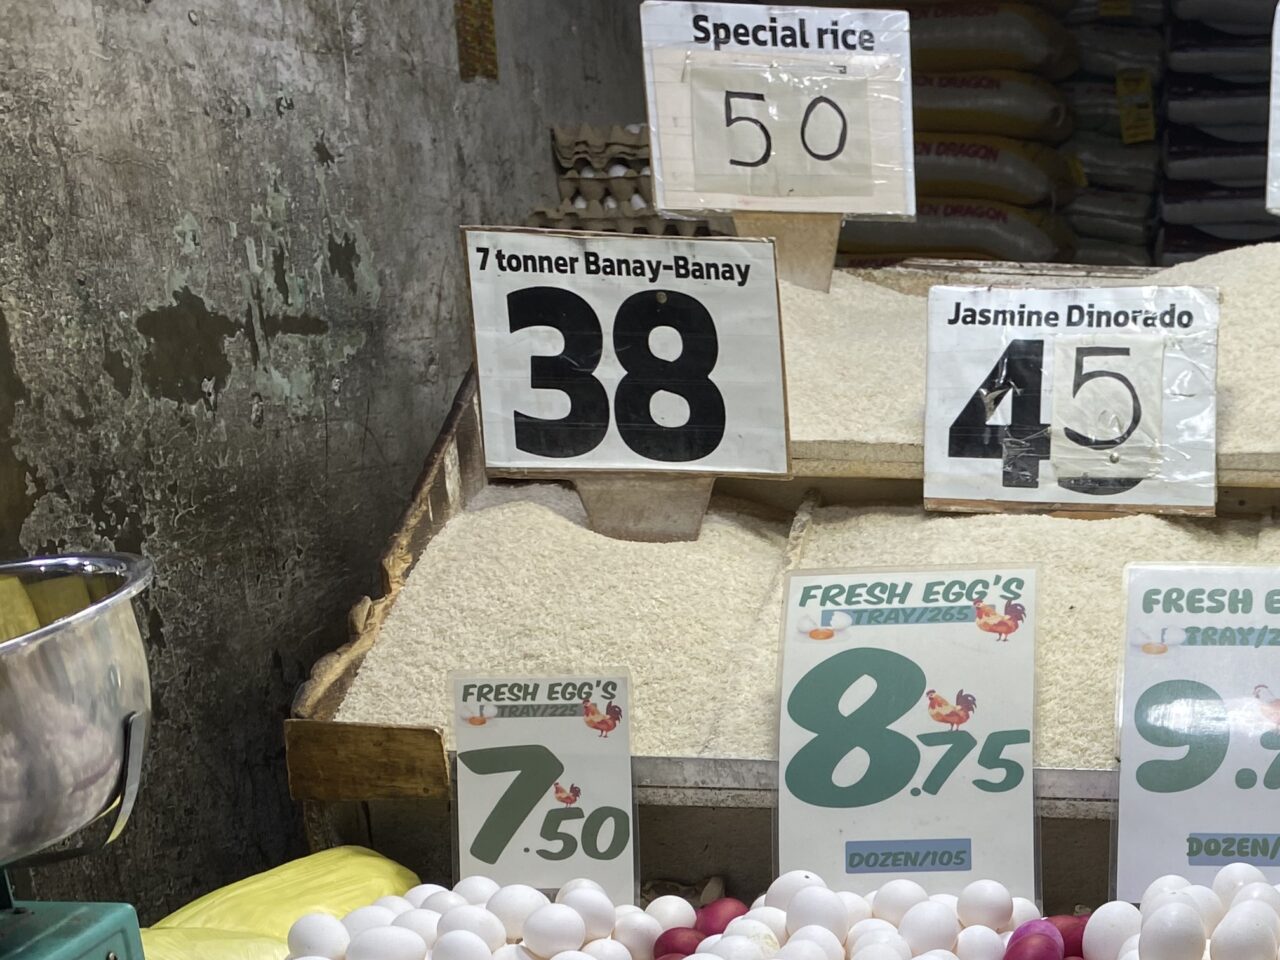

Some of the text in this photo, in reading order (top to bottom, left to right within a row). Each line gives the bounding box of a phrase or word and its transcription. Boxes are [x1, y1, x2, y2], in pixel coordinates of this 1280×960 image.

[693, 15, 874, 51] Special rice
[724, 91, 847, 167] 50
[476, 248, 751, 286] 7 tonner Banay-Banay
[948, 302, 1193, 328] Jasmine Dinorado
[506, 286, 726, 462] 38
[799, 574, 1025, 607] FRESH EGG'S
[1142, 587, 1253, 615] FRESH
[853, 605, 970, 626] TRAY/265
[462, 680, 617, 702] FRESH EGG'S
[499, 704, 579, 718] TRAY/225
[784, 647, 1031, 809] 8.75
[457, 744, 630, 865] 7.50
[848, 850, 967, 869] DOZEN/105
